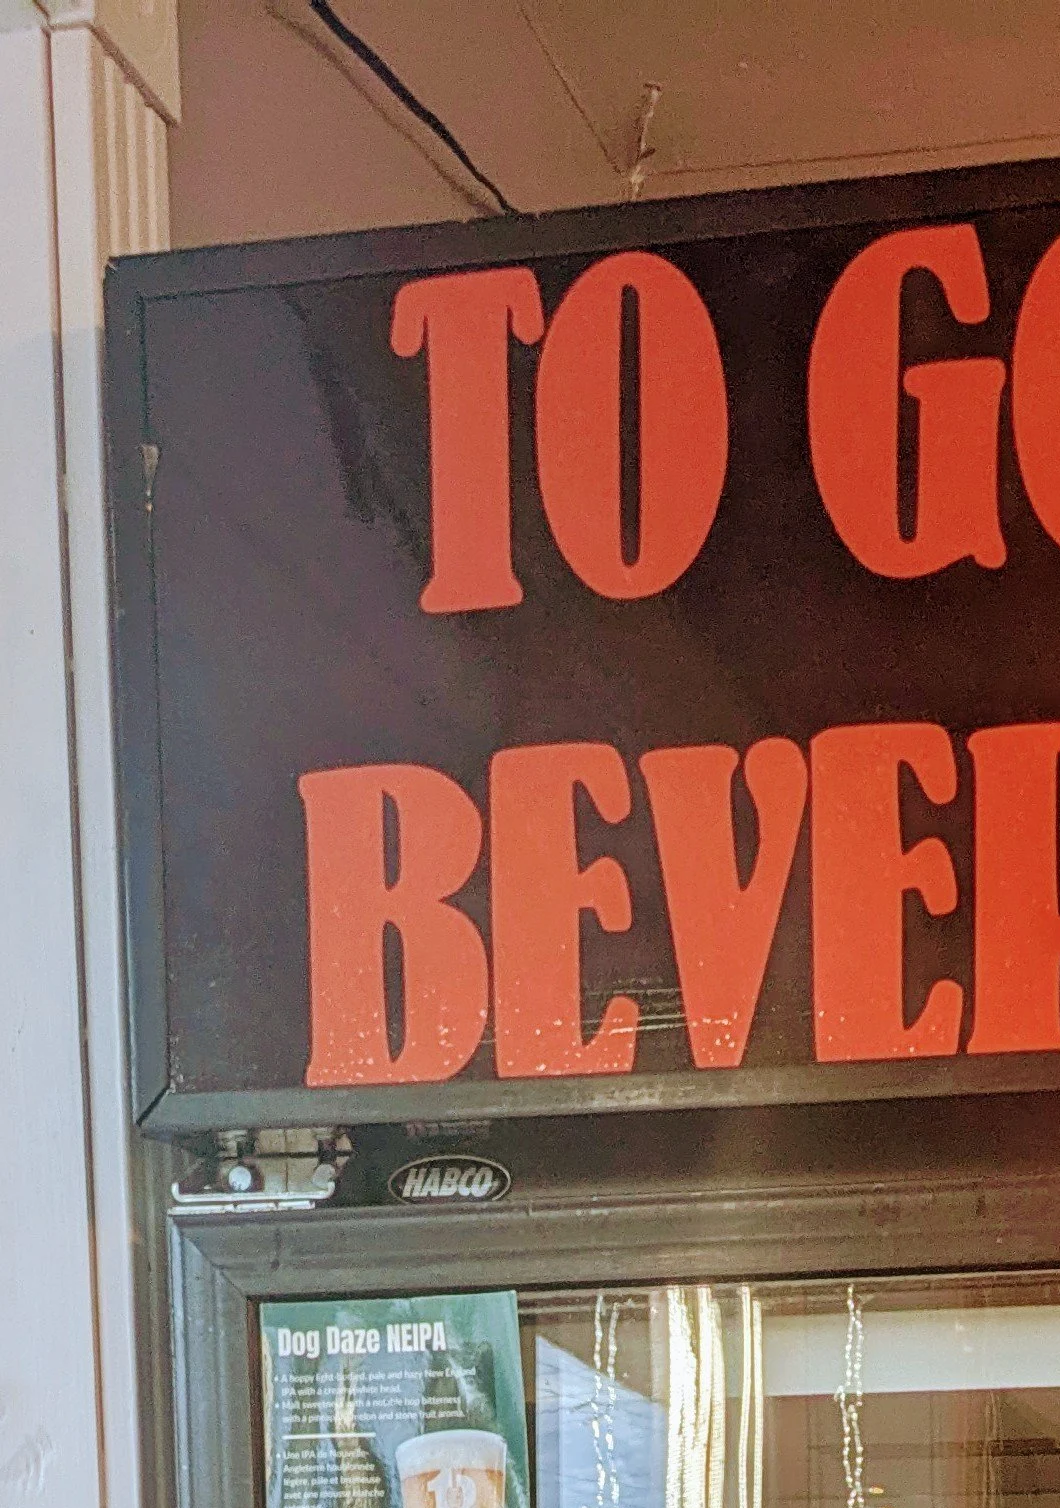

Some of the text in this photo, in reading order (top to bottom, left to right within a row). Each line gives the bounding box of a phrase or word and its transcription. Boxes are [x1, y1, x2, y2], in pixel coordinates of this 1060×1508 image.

[391, 250, 728, 616] TO
[402, 1167, 493, 1197] HABCO
[278, 1322, 446, 1358] Dog Daze NEIPA
